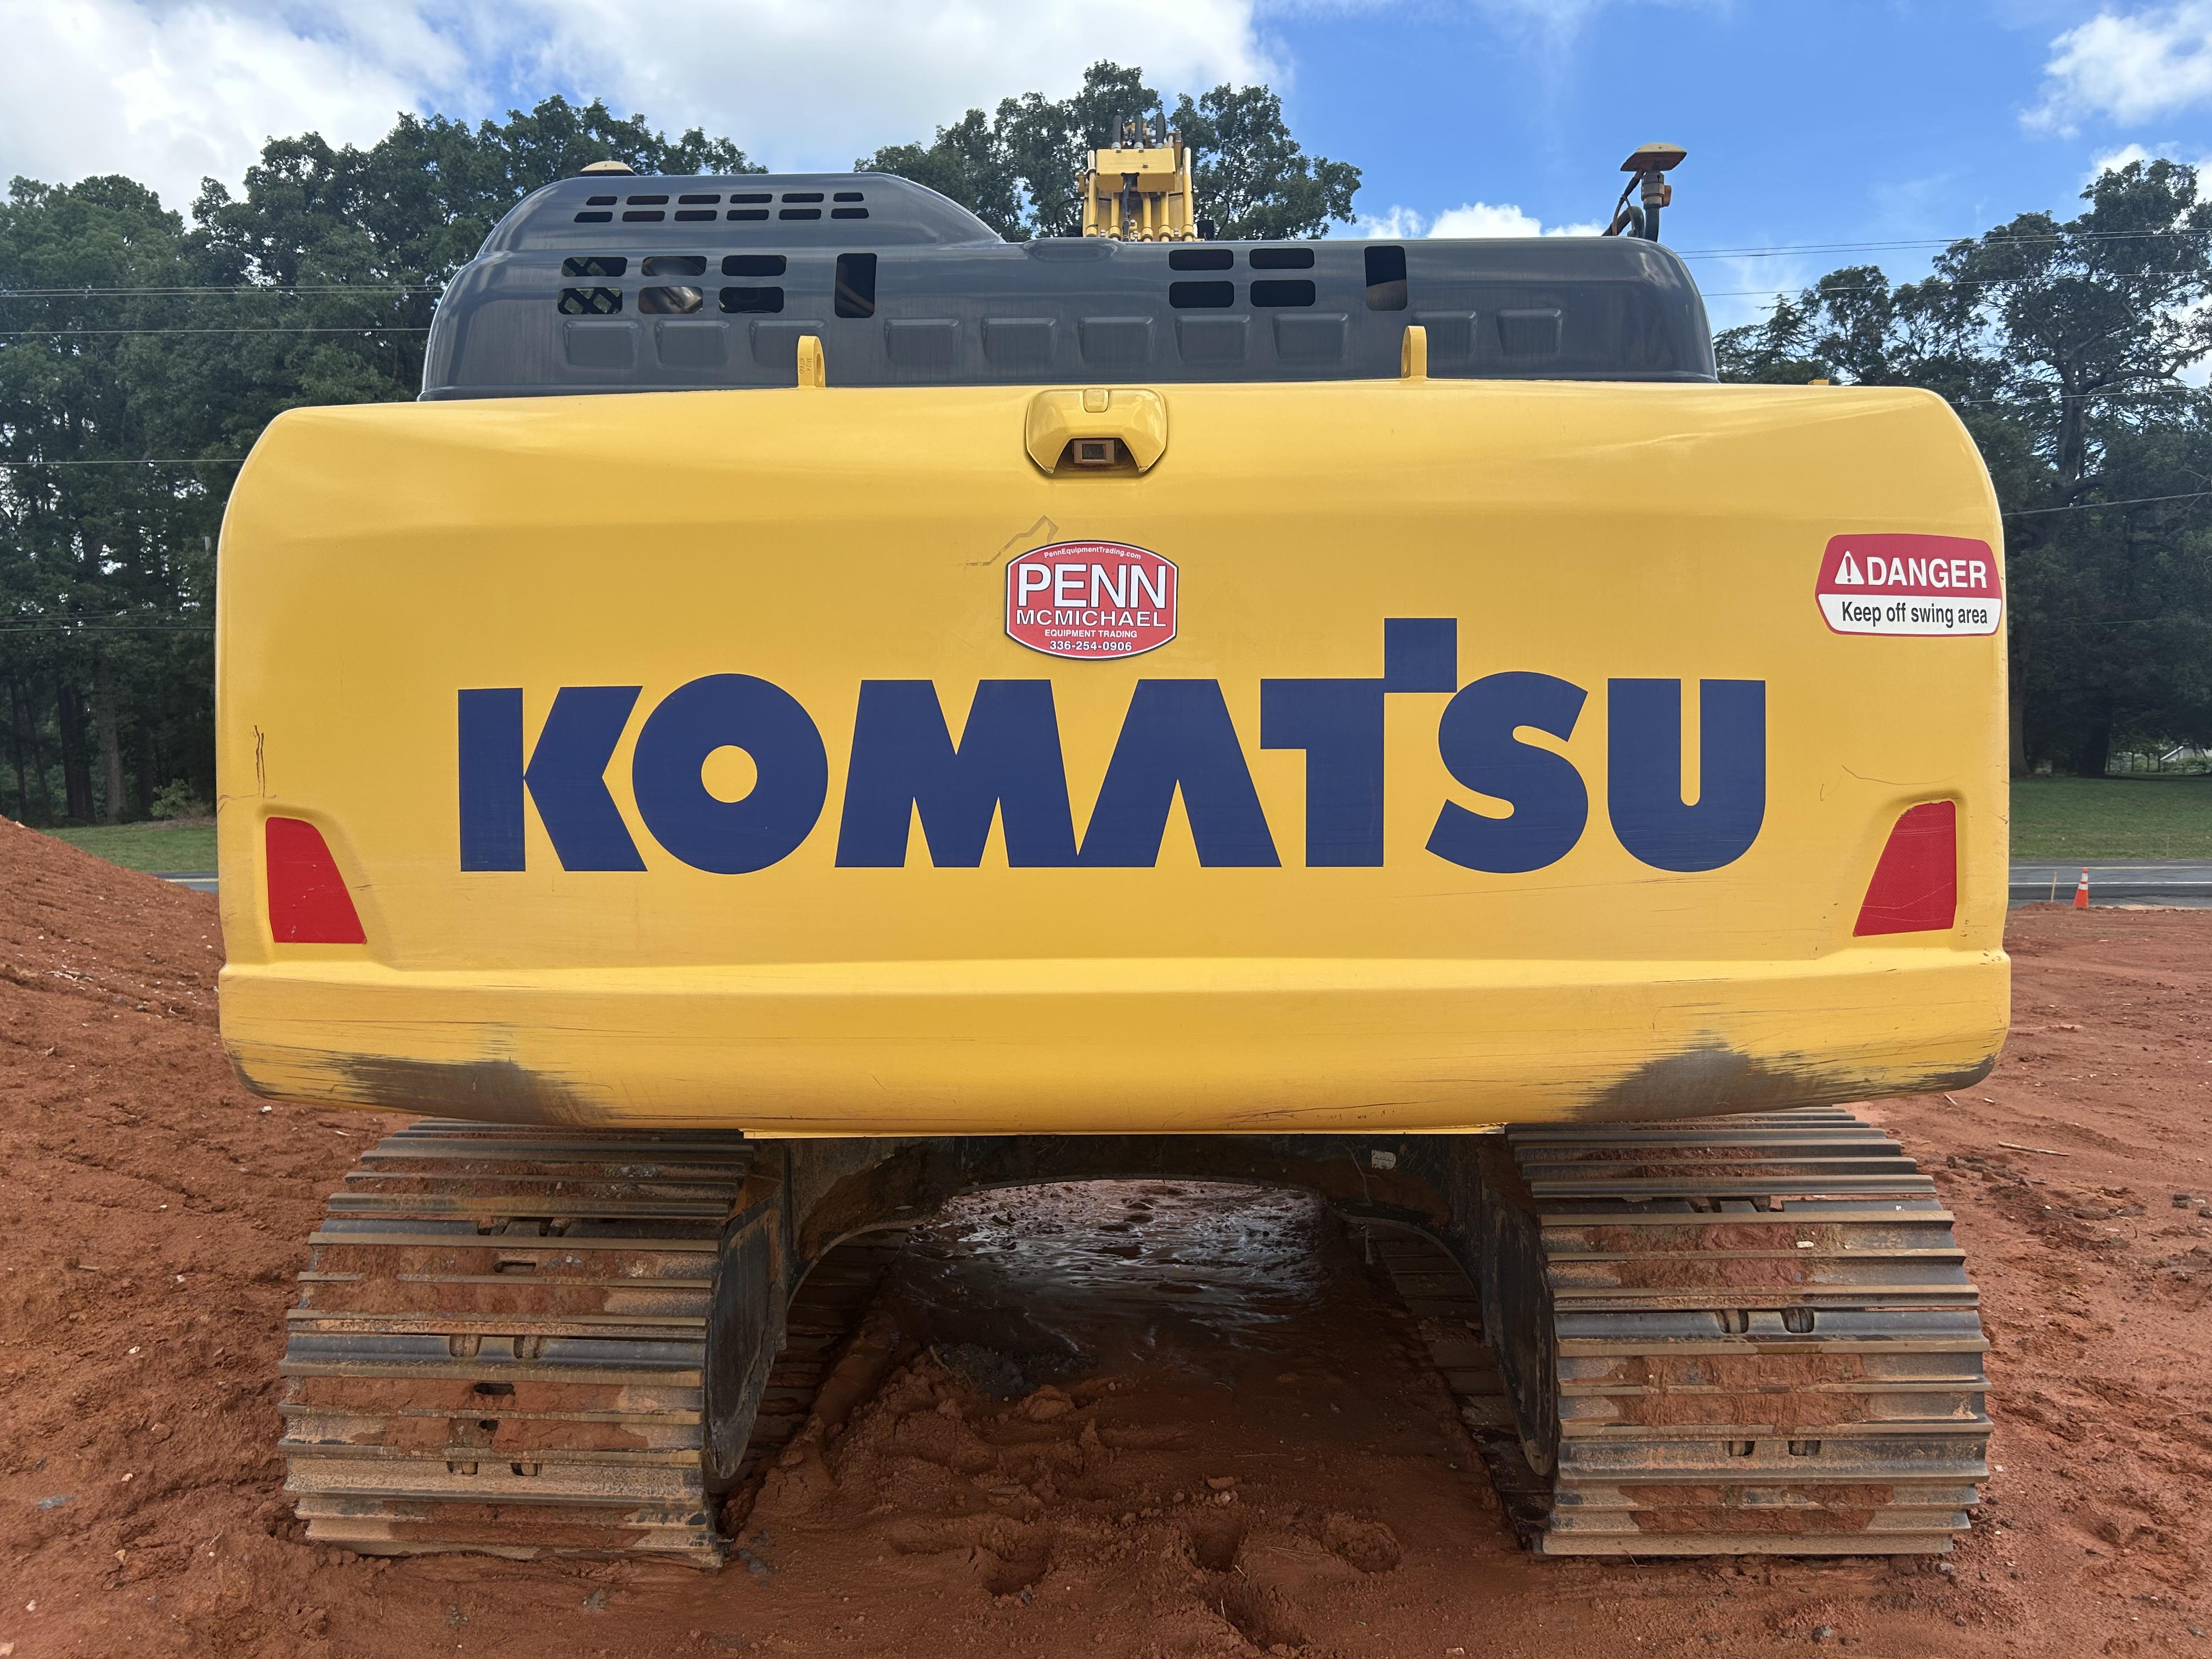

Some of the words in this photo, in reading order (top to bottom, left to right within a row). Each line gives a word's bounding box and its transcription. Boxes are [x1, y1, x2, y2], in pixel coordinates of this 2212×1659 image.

[1044, 546, 1141, 560] PennEquipmentTrading.com
[1866, 556, 1987, 589] DANGER
[1018, 563, 1166, 608] PENN
[1017, 610, 1166, 627] MCMICHAEL
[1842, 601, 1882, 627] Keep
[1887, 602, 1906, 622] off
[1911, 603, 1953, 628] swing
[1958, 608, 1988, 624] area
[1045, 629, 1096, 637] EQUIPMENT
[1098, 630, 1137, 638] TRADING
[1049, 641, 1132, 651] 336-254-0906
[458, 618, 1767, 876] KOMATSU
